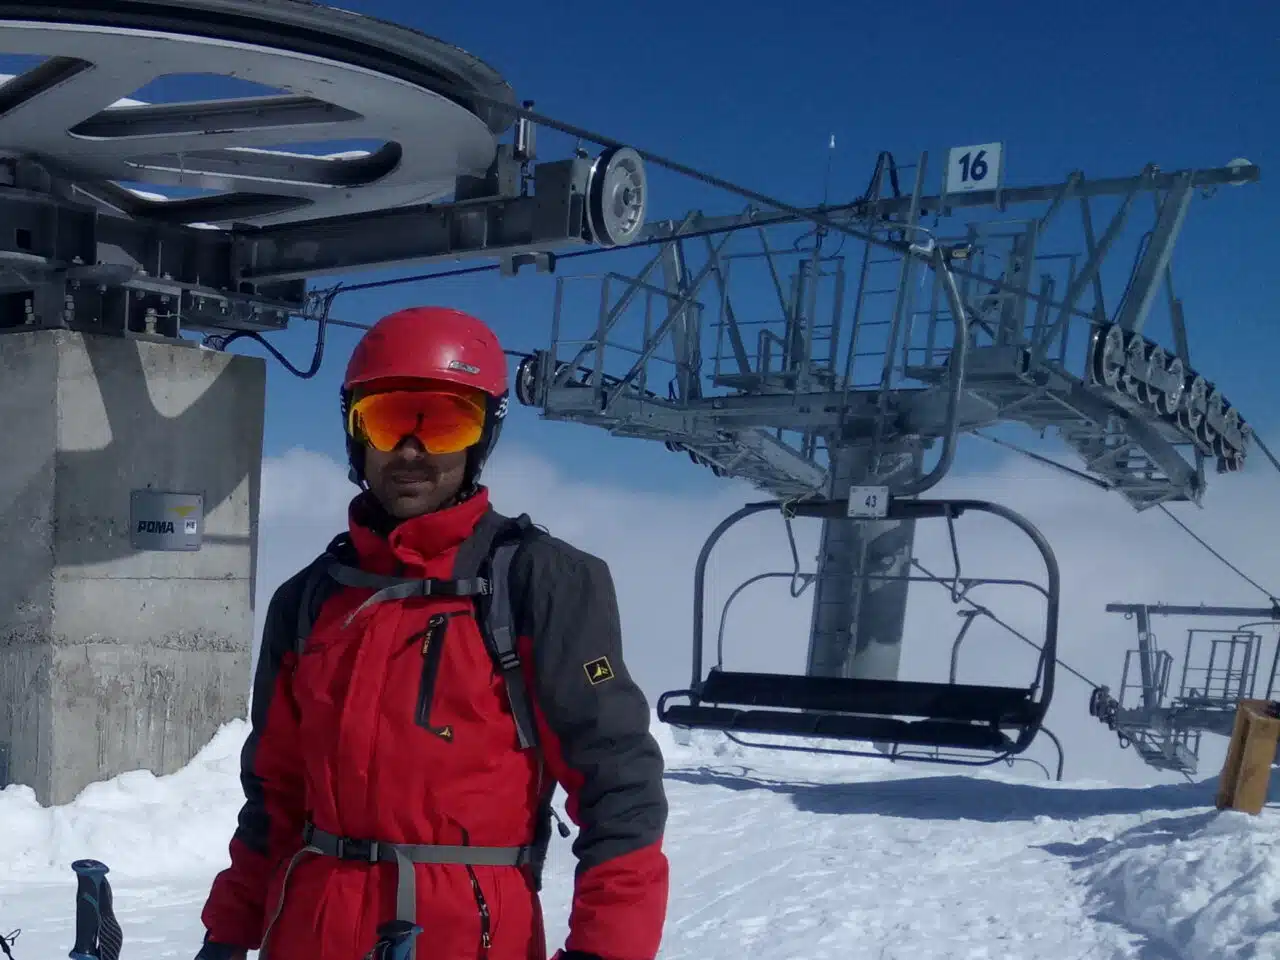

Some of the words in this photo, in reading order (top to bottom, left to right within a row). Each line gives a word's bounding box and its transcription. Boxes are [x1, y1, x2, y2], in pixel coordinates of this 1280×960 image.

[959, 150, 988, 182] 16
[864, 495, 877, 508] 43
[137, 520, 174, 534] POMA
